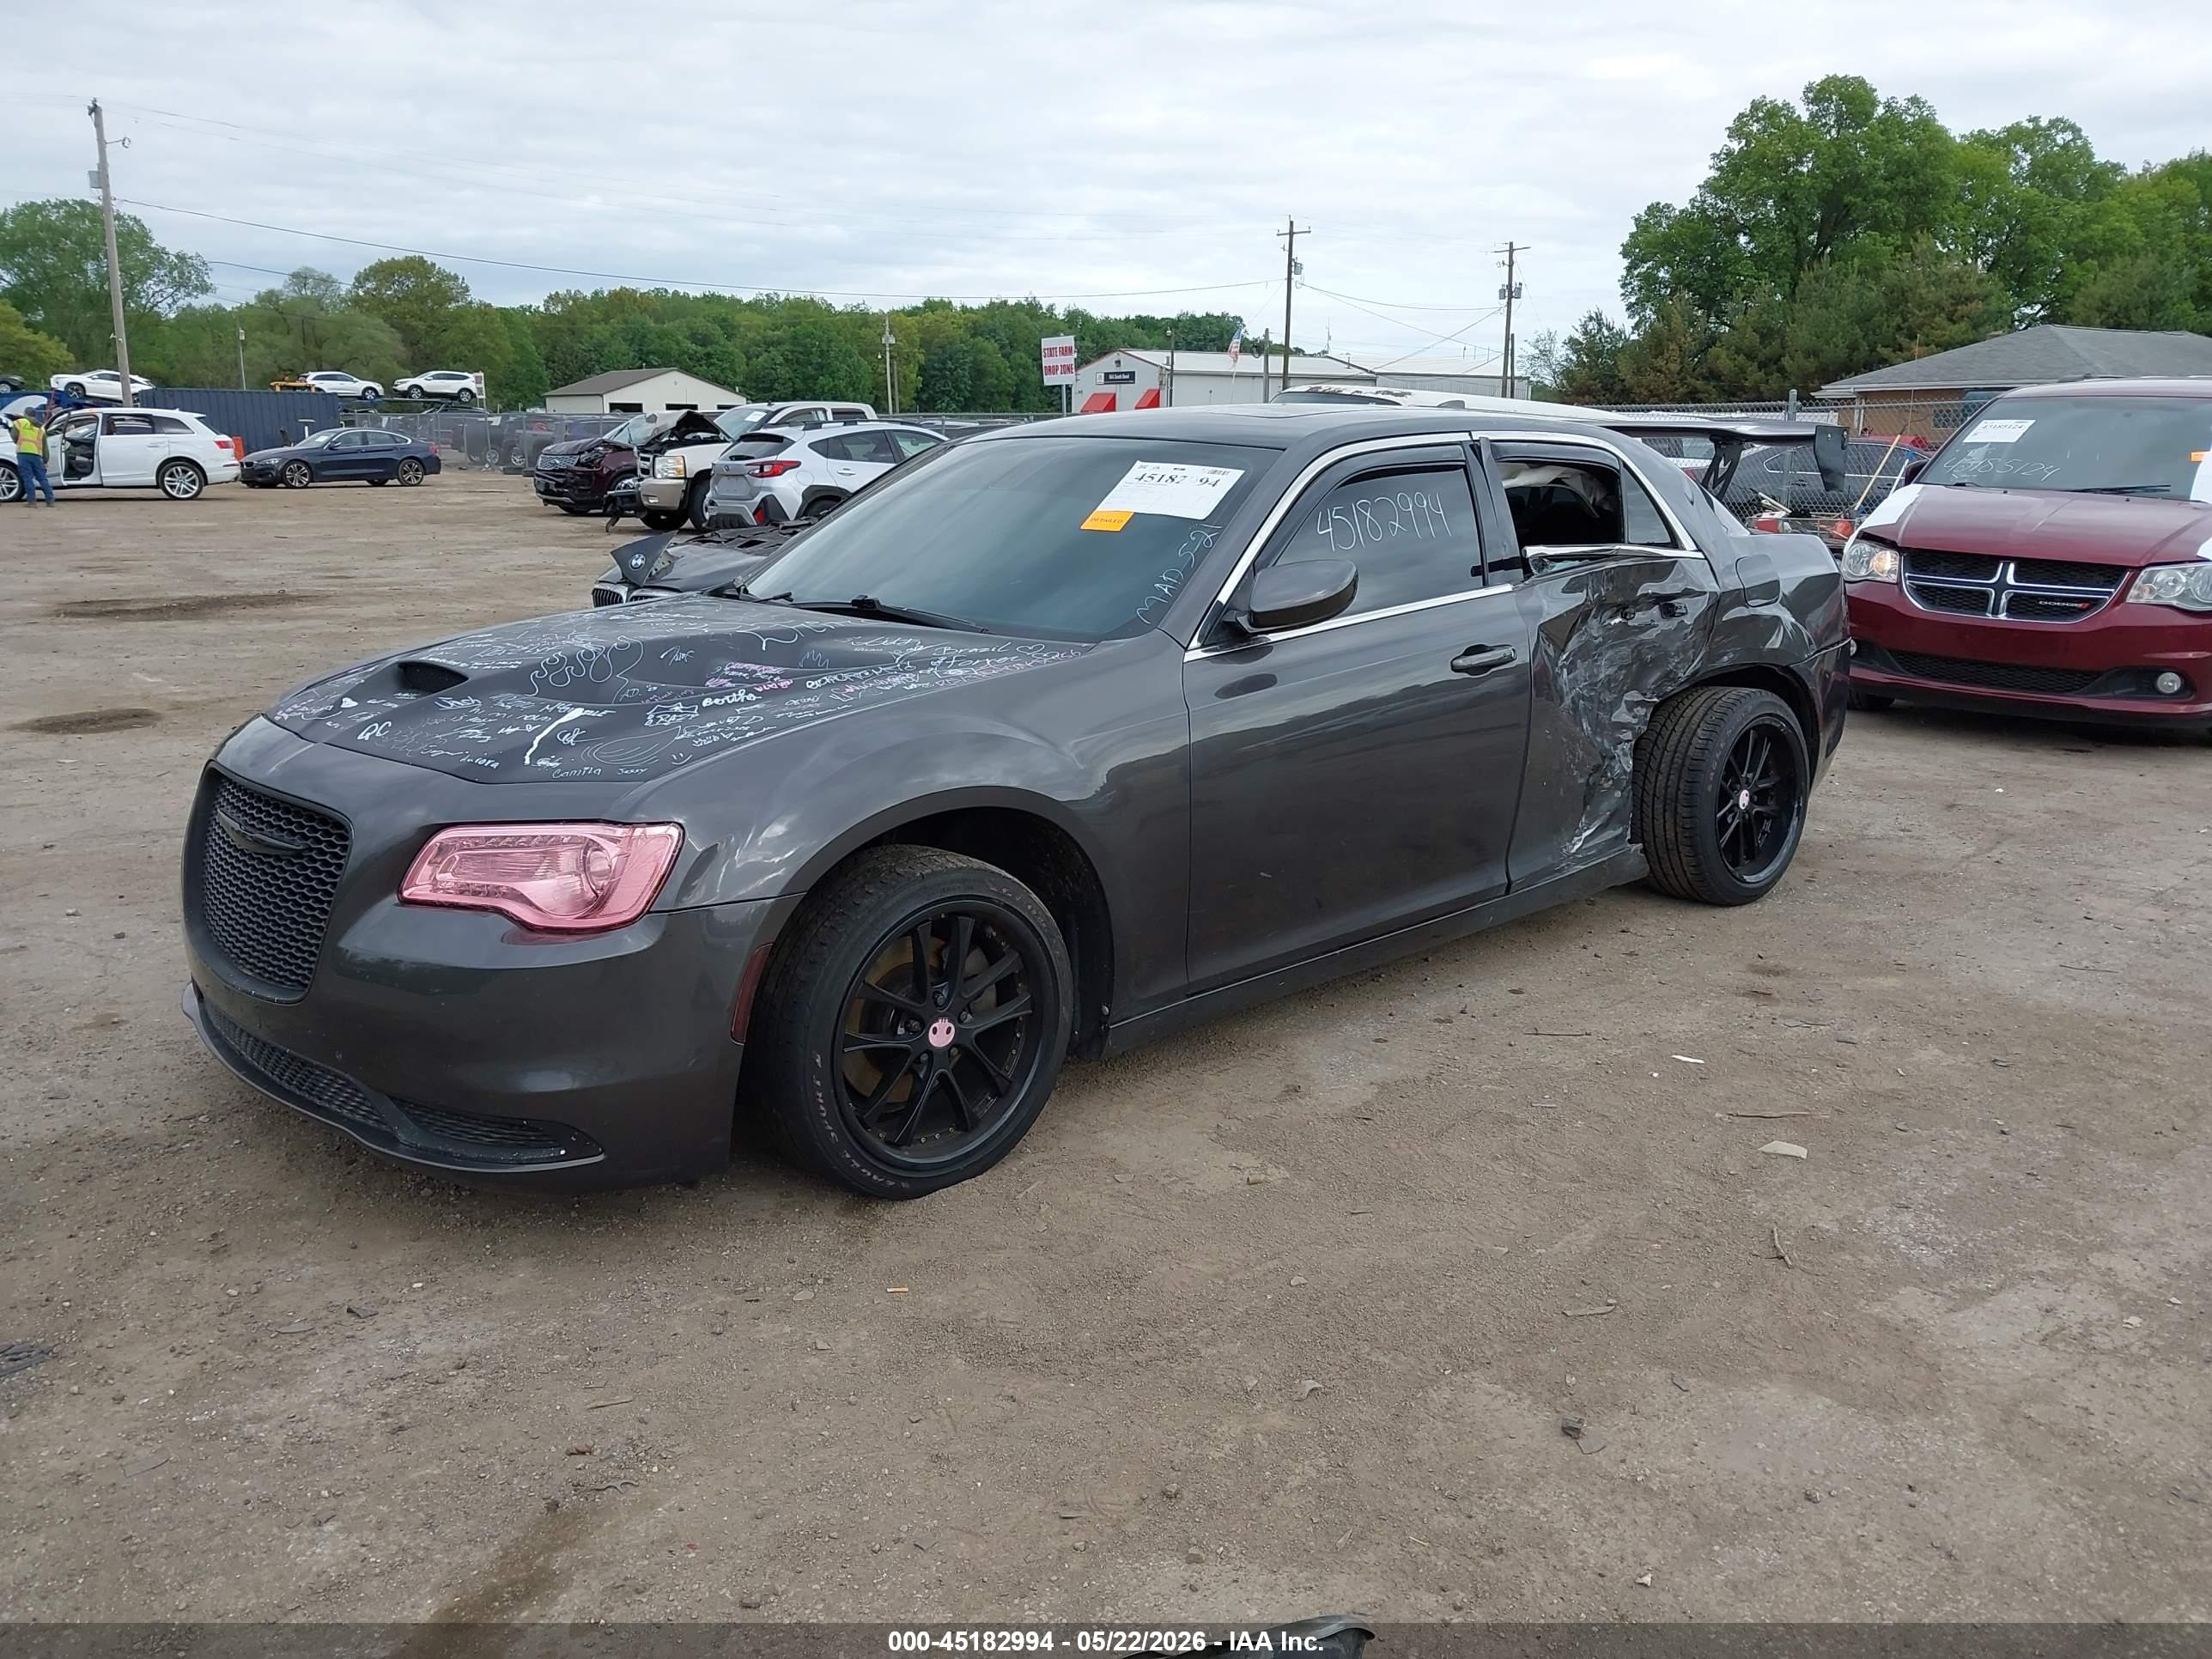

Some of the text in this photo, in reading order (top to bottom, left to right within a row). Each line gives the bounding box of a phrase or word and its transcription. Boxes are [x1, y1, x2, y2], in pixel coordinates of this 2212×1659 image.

[1043, 345, 1073, 358] STATE FARM
[1044, 363, 1073, 375] DROP ZONE
[1133, 472, 1221, 488] 4518294
[1317, 492, 1452, 552] 45182994
[1136, 568, 1184, 624] MAD
